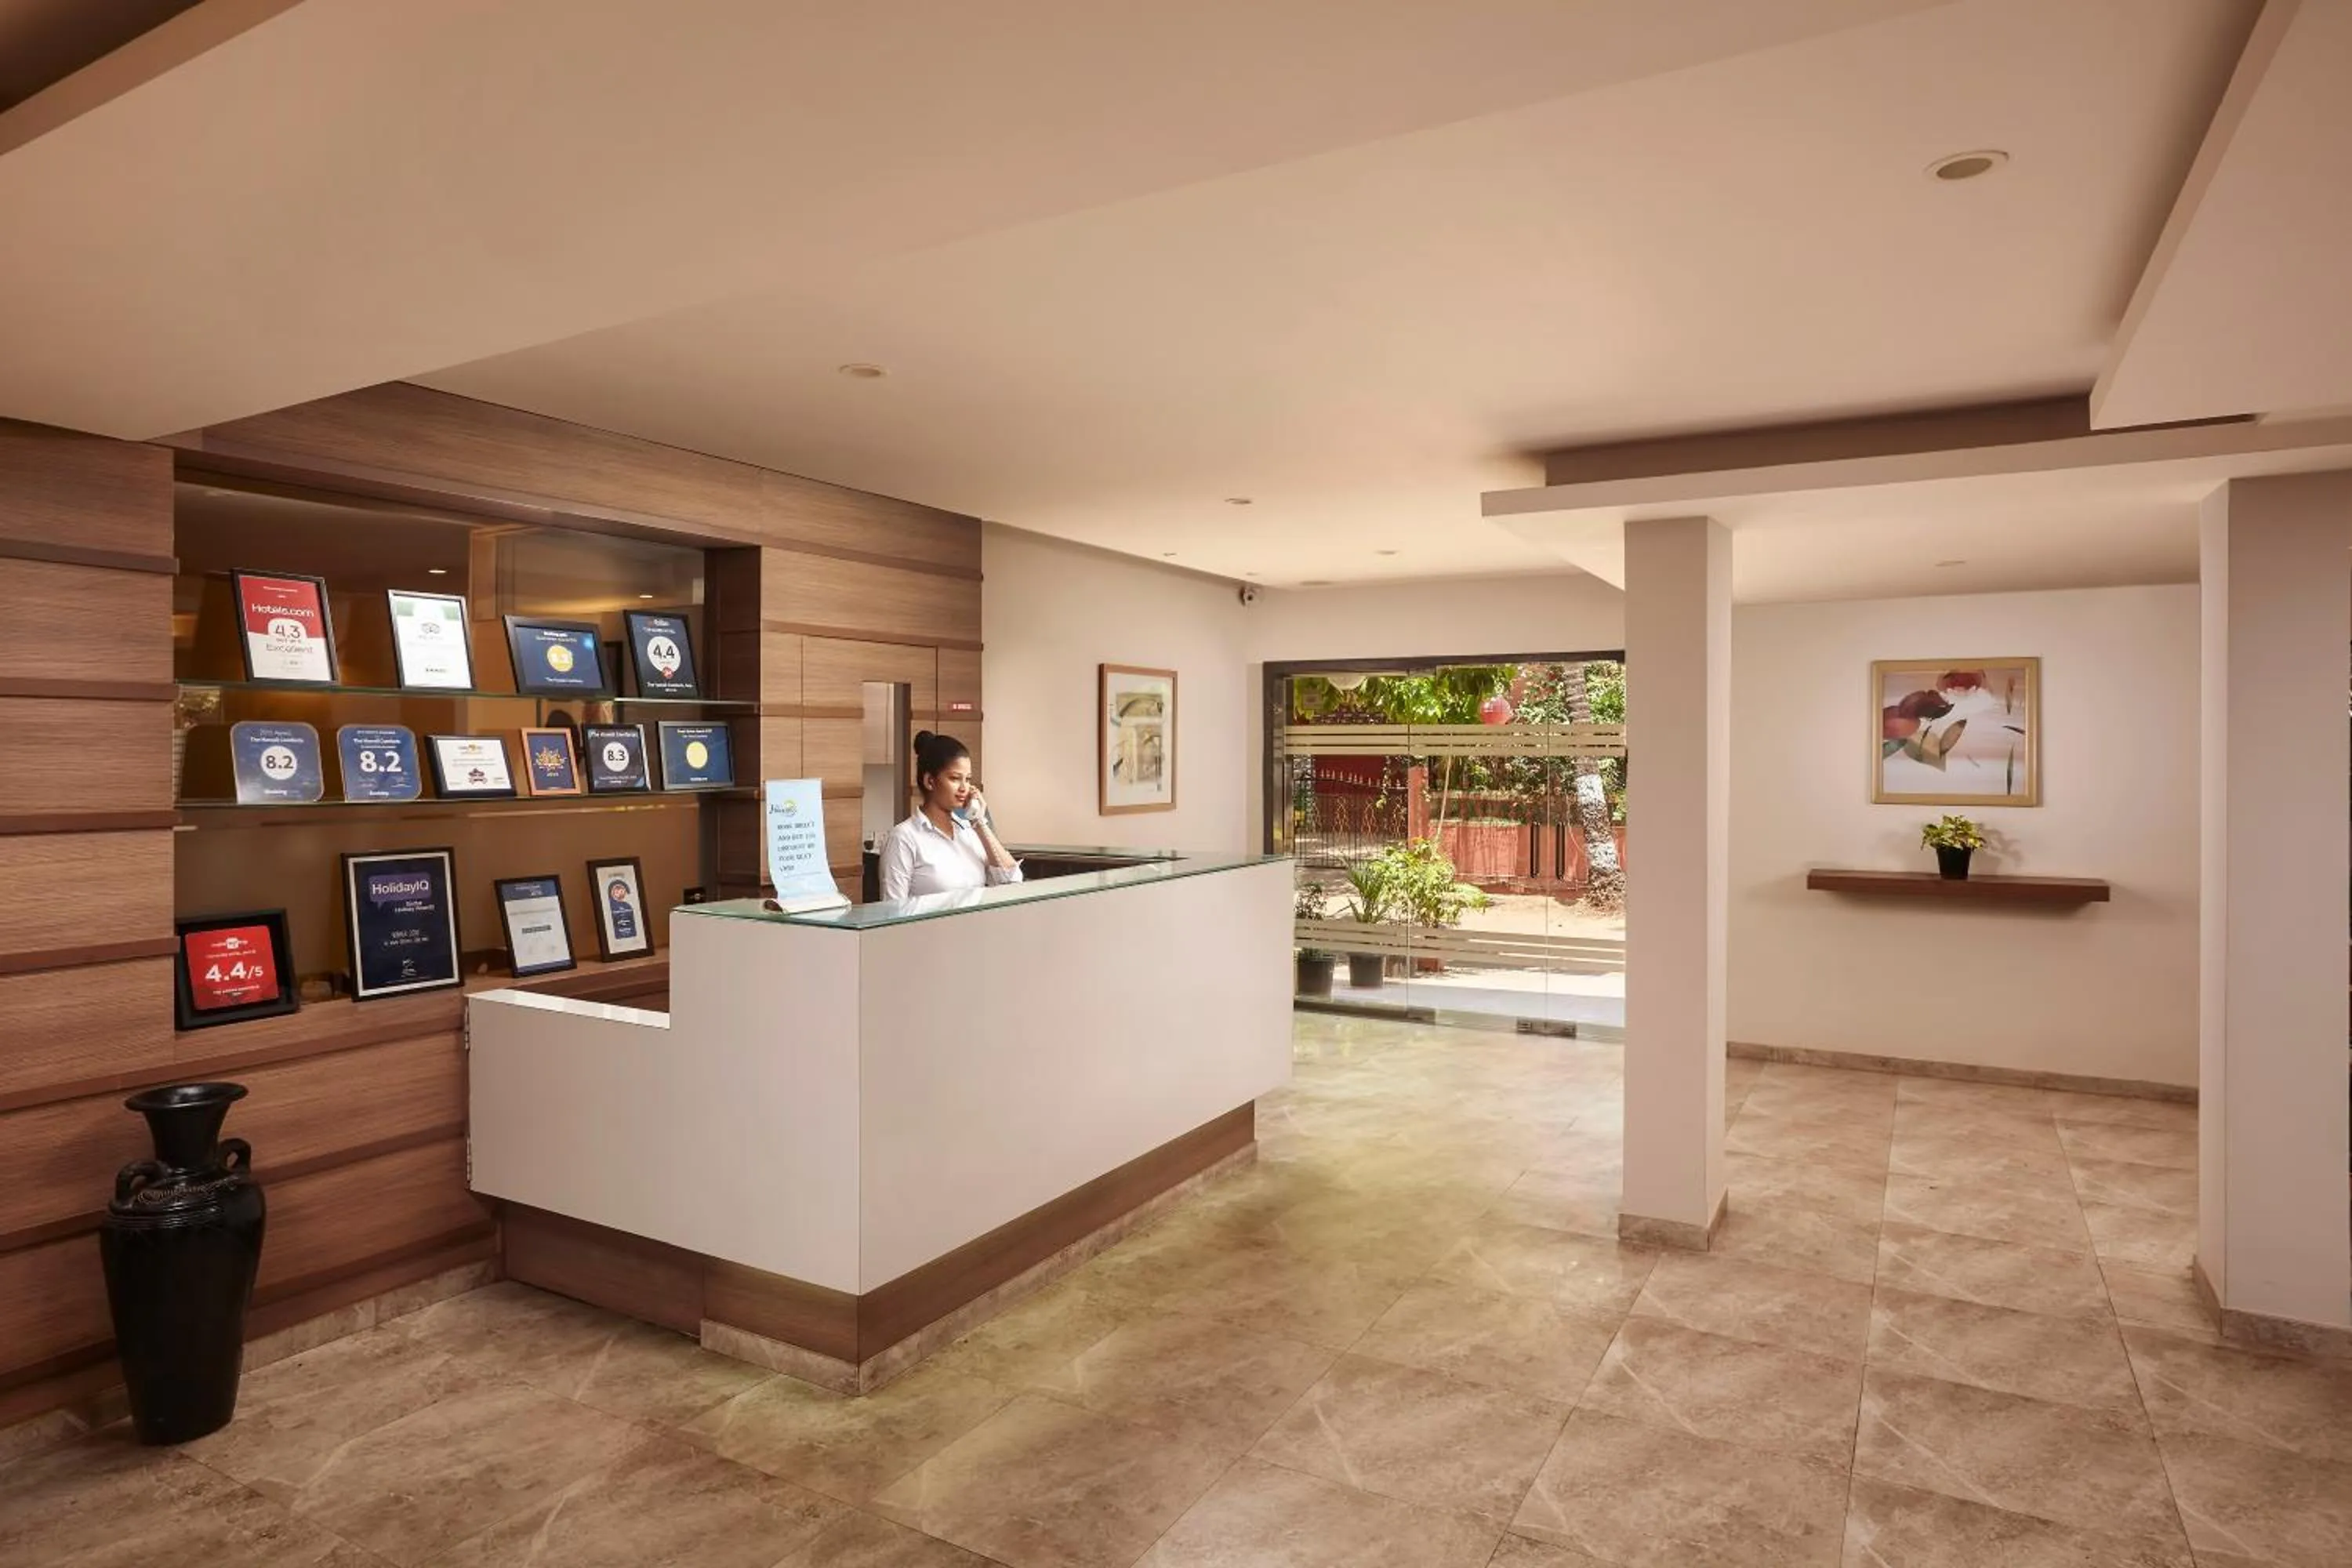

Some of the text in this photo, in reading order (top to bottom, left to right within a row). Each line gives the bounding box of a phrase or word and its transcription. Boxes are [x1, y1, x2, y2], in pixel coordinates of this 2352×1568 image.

[252, 603, 314, 617] Hotels.com
[275, 624, 301, 638] 4.3
[653, 644, 675, 659] 4.4
[266, 755, 294, 769] 8.2
[360, 750, 402, 772] 8.2
[608, 750, 626, 761] 8.3
[372, 880, 429, 895] HolidayIQ
